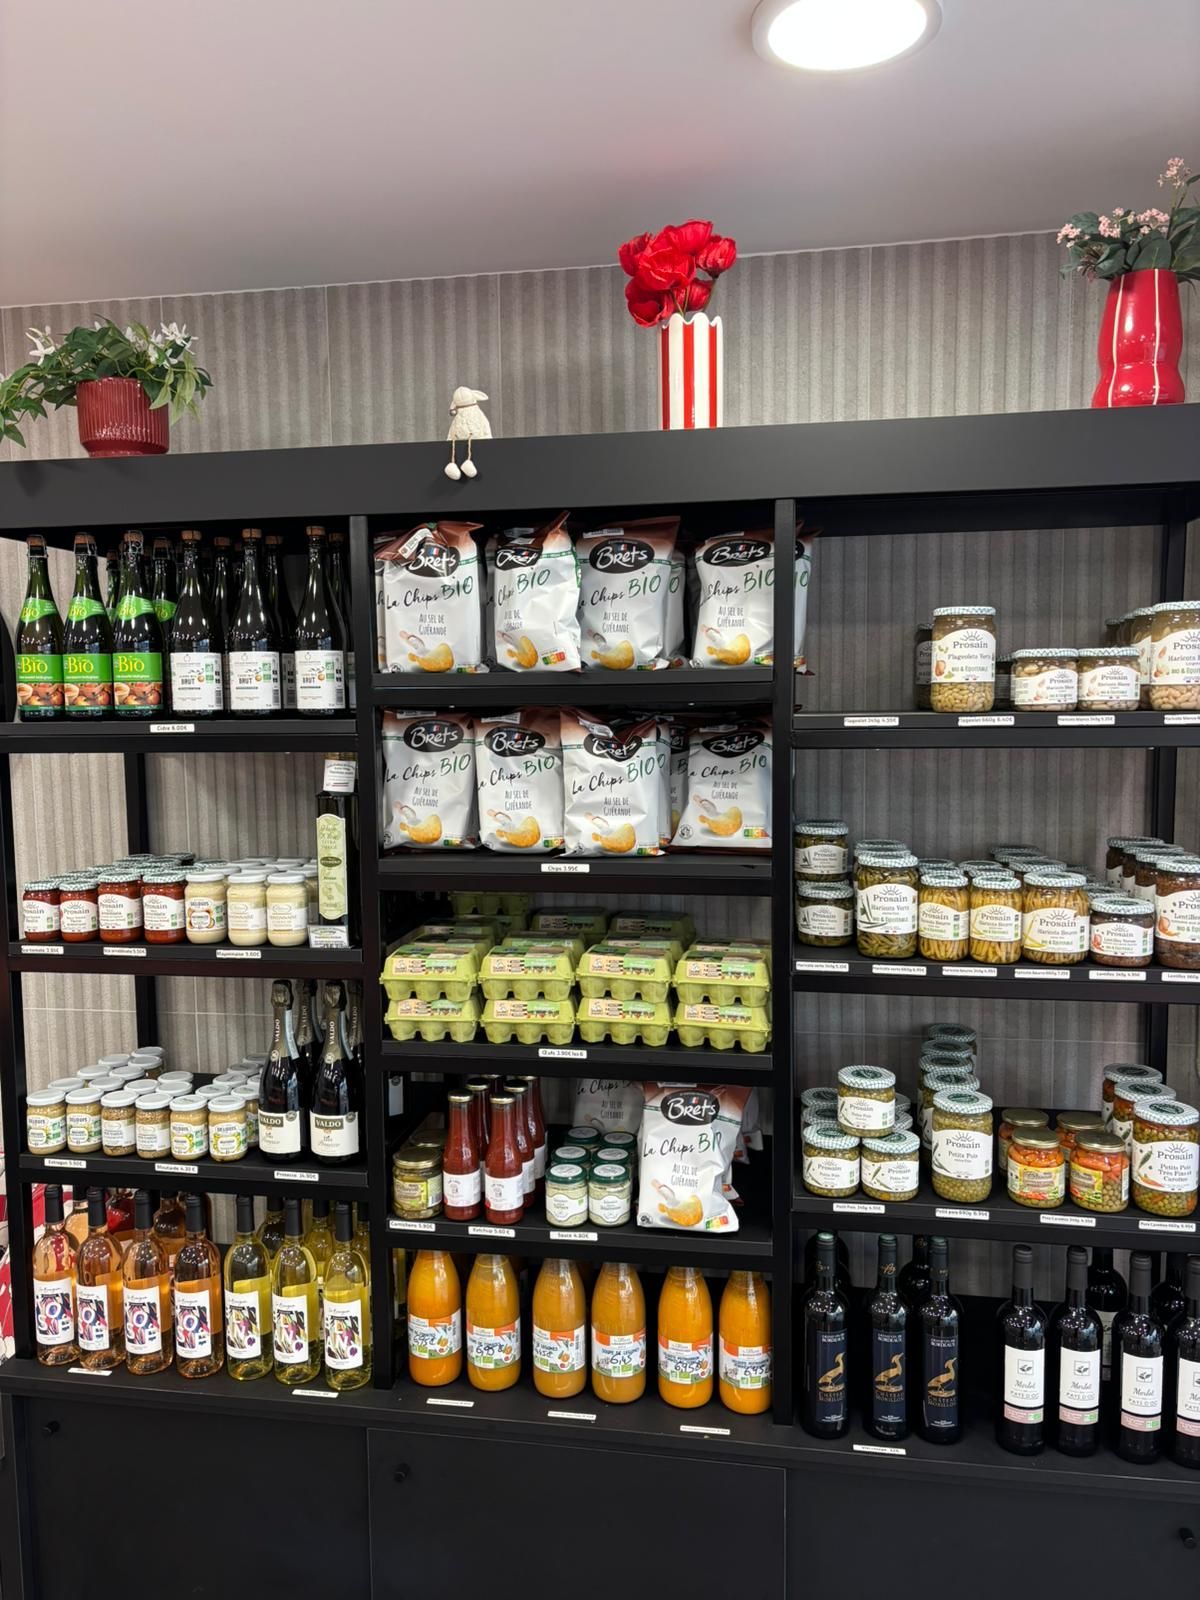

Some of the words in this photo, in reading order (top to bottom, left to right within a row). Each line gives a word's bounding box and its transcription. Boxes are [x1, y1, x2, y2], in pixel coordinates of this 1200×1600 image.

[596, 546, 649, 569] Brets
[712, 545, 765, 564] Brets
[403, 587, 439, 609] Chips
[590, 586, 625, 608] Chips
[953, 641, 988, 649] Prosain
[21, 656, 48, 673] Bio
[67, 656, 94, 673] Bio
[118, 655, 145, 673] Bio
[410, 726, 458, 747] Brets
[493, 731, 540, 752] Brets
[710, 734, 758, 753] Brets
[402, 764, 437, 784] Chips
[490, 768, 522, 786] Chips
[701, 766, 737, 781] Chips
[589, 772, 625, 793] Chips
[873, 893, 908, 903] Prosain
[921, 911, 949, 920] Prosain
[981, 913, 1012, 921] Prosain
[1039, 918, 1077, 928] Prosain
[667, 1097, 716, 1121] Brets
[315, 1119, 342, 1127] VALDO
[643, 1142, 656, 1158] La
[660, 1137, 695, 1160] Chips
[945, 1138, 981, 1149] Prosain
[1157, 1151, 1193, 1161] Prosain
[1014, 1380, 1036, 1389] Merlot
[1070, 1381, 1093, 1390] Merlot
[1133, 1387, 1155, 1397] Merlot
